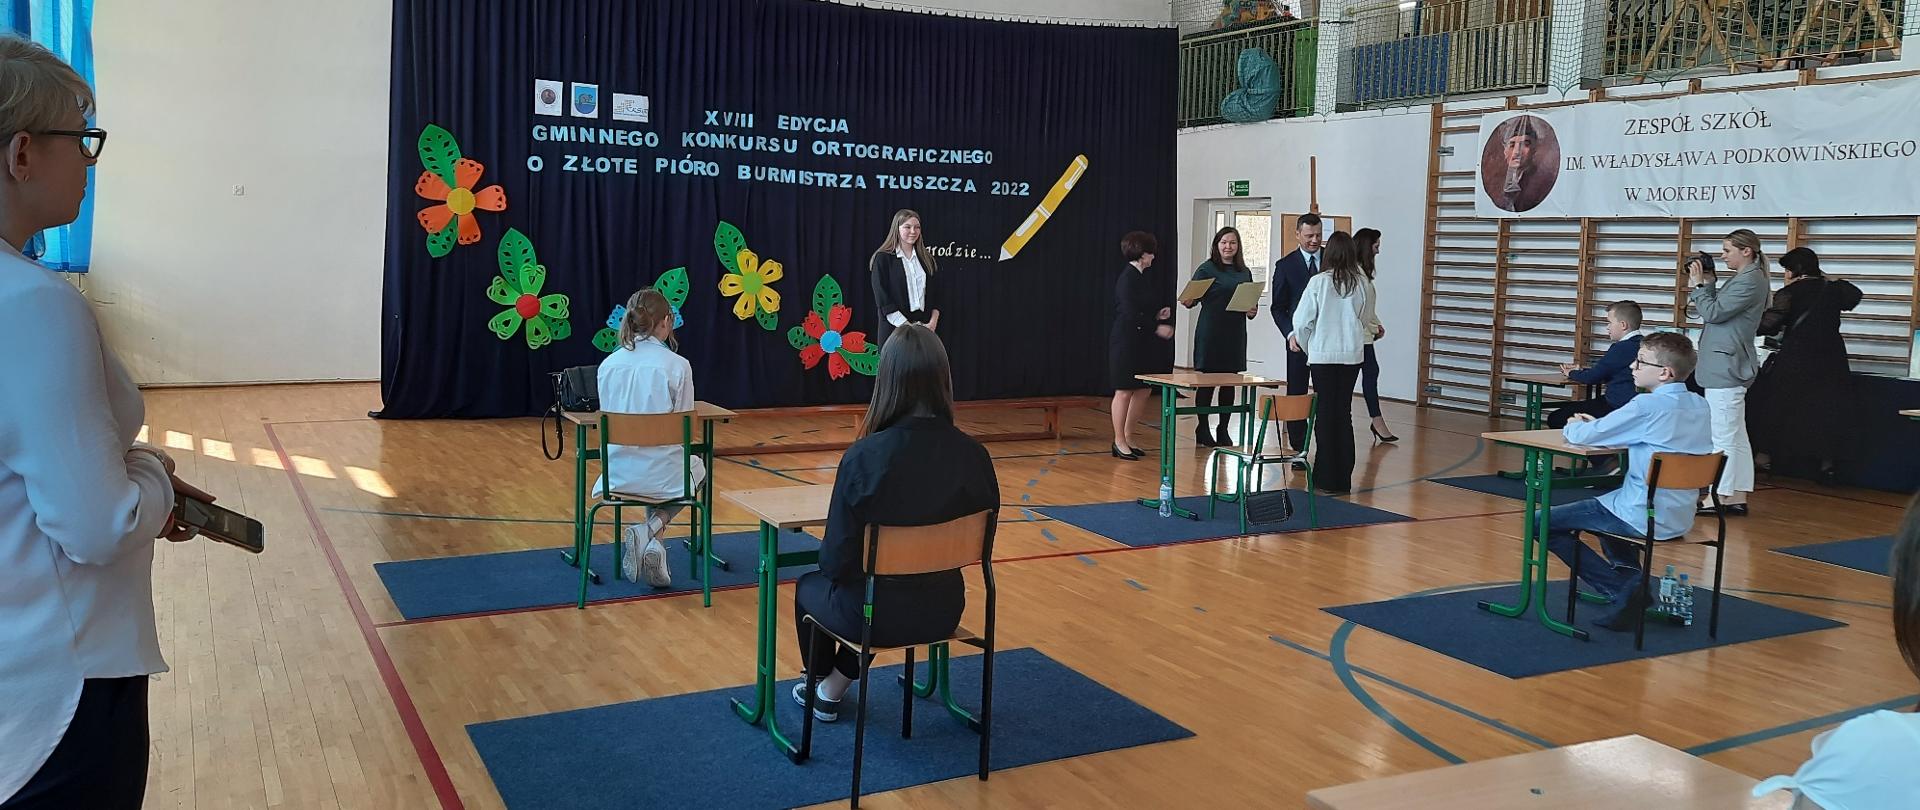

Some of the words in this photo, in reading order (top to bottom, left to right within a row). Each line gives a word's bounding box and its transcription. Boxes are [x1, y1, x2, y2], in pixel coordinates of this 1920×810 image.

[704, 110, 754, 128] XVIII
[777, 114, 849, 133] EDYCJA
[1624, 112, 1695, 136] ZESPÓŁ
[1700, 107, 1772, 131] SZKÓŁ
[532, 125, 660, 148] GMINNEGO
[682, 132, 797, 153] KONKURSU
[812, 141, 993, 165] ORTOGRAFICZNEGO
[1565, 155, 1586, 171] IM.
[1592, 150, 1719, 169] WŁADYSŁAWA
[1723, 139, 1917, 166] PODKOWIŃSKIEGO
[527, 155, 544, 172] O
[563, 154, 638, 175] ZŁOTE
[655, 154, 720, 177] PIÓRO
[738, 165, 867, 189] BURMISTRZA
[876, 175, 977, 193] TŁUSZCZA
[991, 181, 1030, 196] 2022
[1624, 187, 1642, 202] W
[1646, 185, 1716, 204] MOKREJ
[1721, 184, 1757, 201] WSI
